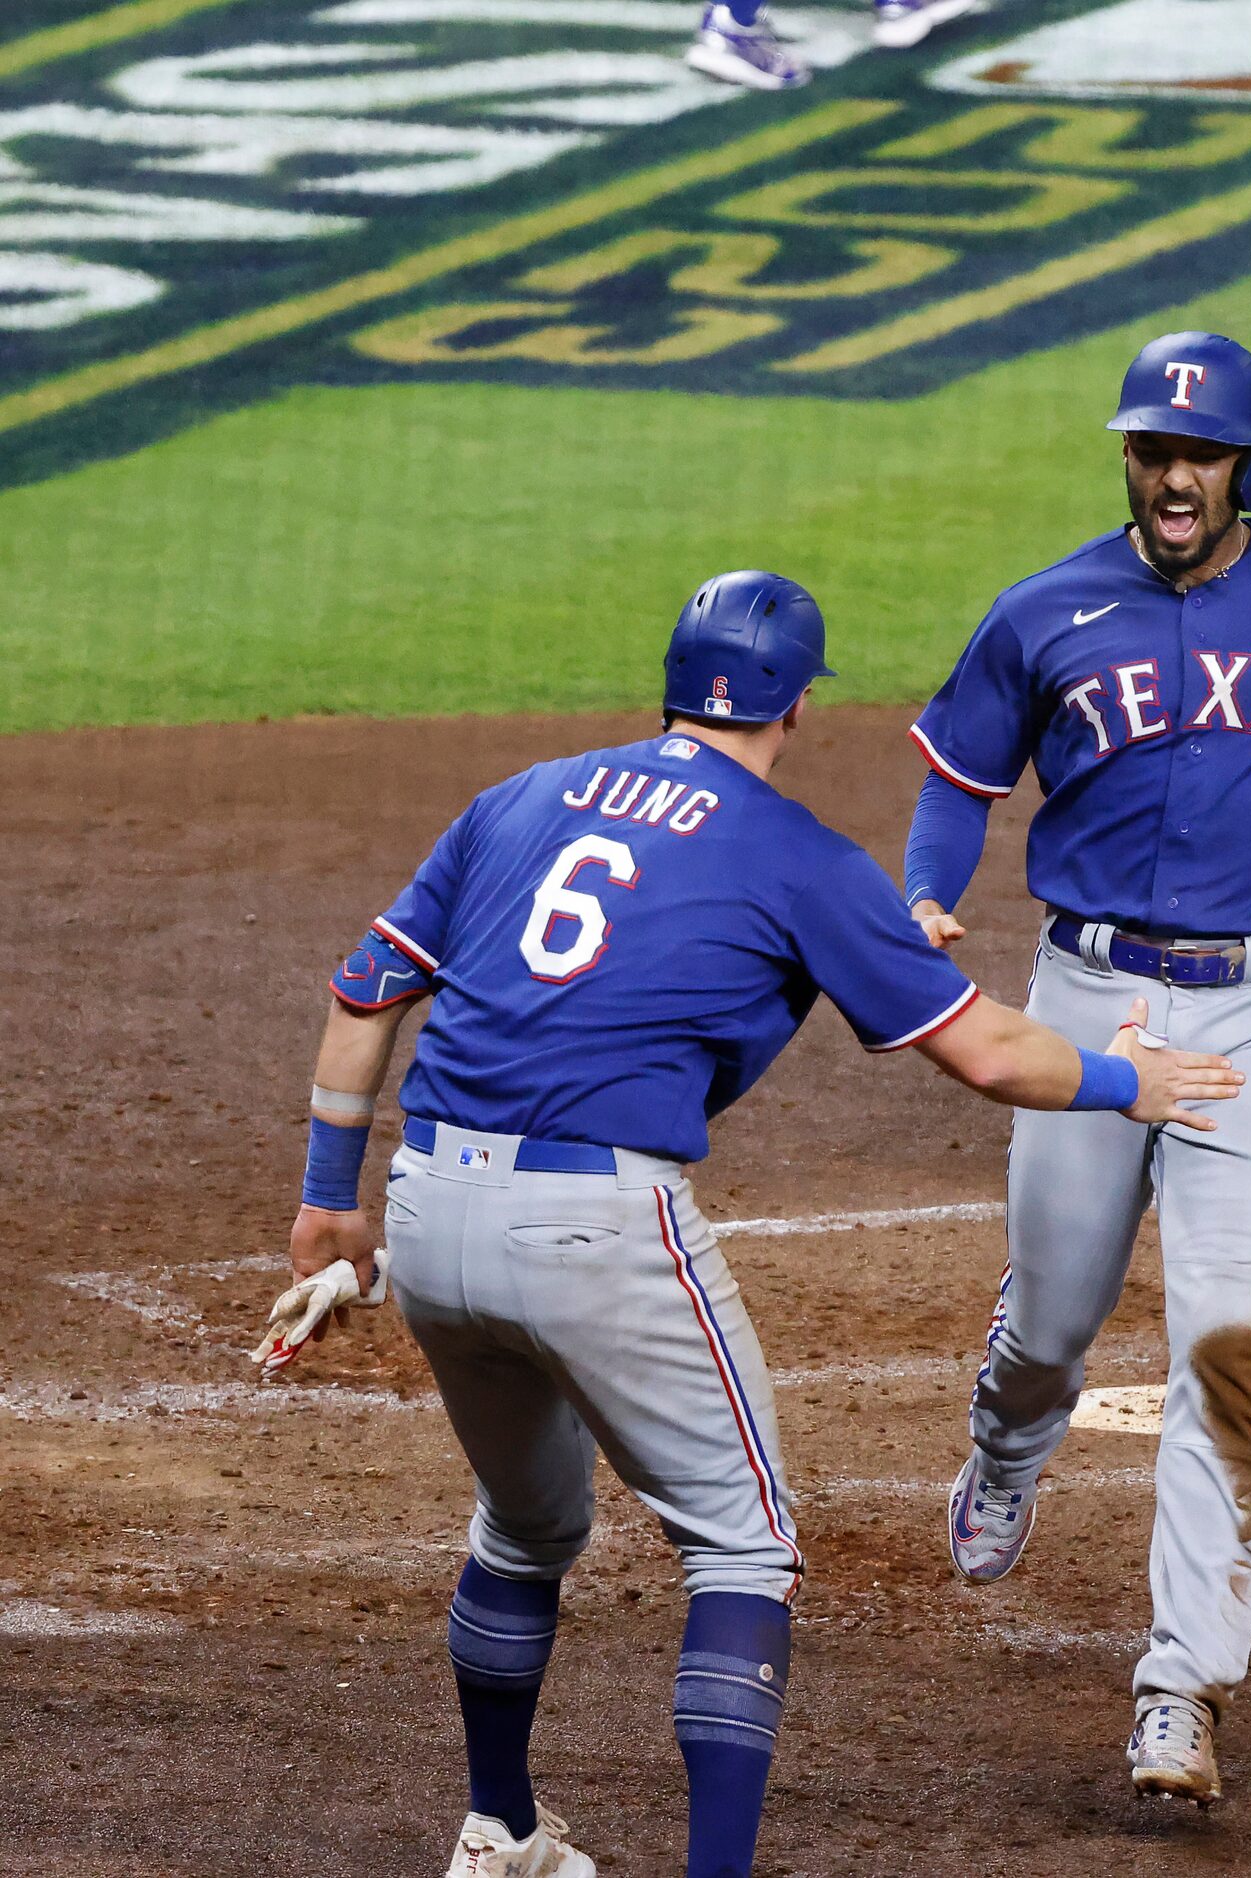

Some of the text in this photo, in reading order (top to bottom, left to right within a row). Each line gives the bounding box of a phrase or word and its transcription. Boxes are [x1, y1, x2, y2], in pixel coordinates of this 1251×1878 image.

[1164, 361, 1207, 410] T
[712, 675, 728, 699] 6
[562, 766, 721, 836] JUNG
[519, 833, 643, 985] 6
[1227, 960, 1236, 980] 2
